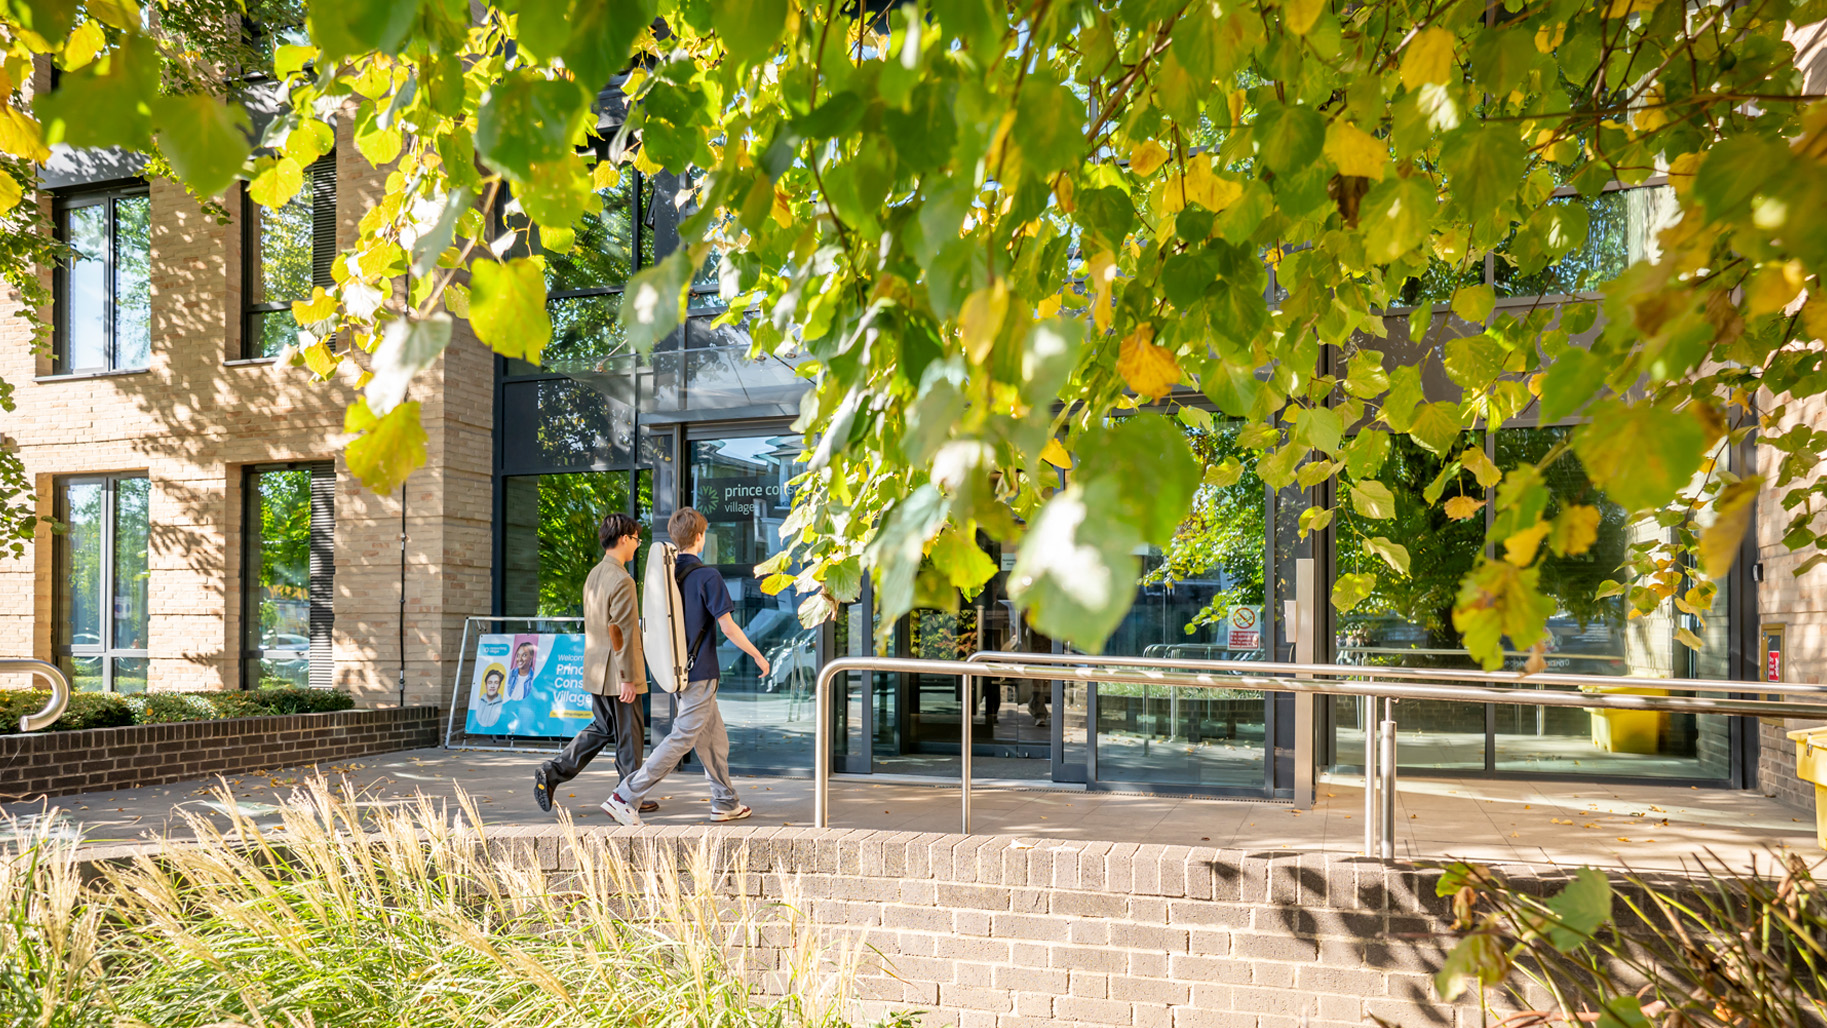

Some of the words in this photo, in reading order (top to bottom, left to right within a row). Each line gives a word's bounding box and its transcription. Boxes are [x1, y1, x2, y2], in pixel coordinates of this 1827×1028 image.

[724, 483, 762, 501] prince
[724, 501, 755, 516] village
[554, 677, 584, 688] Cons
[554, 691, 592, 706] Village
